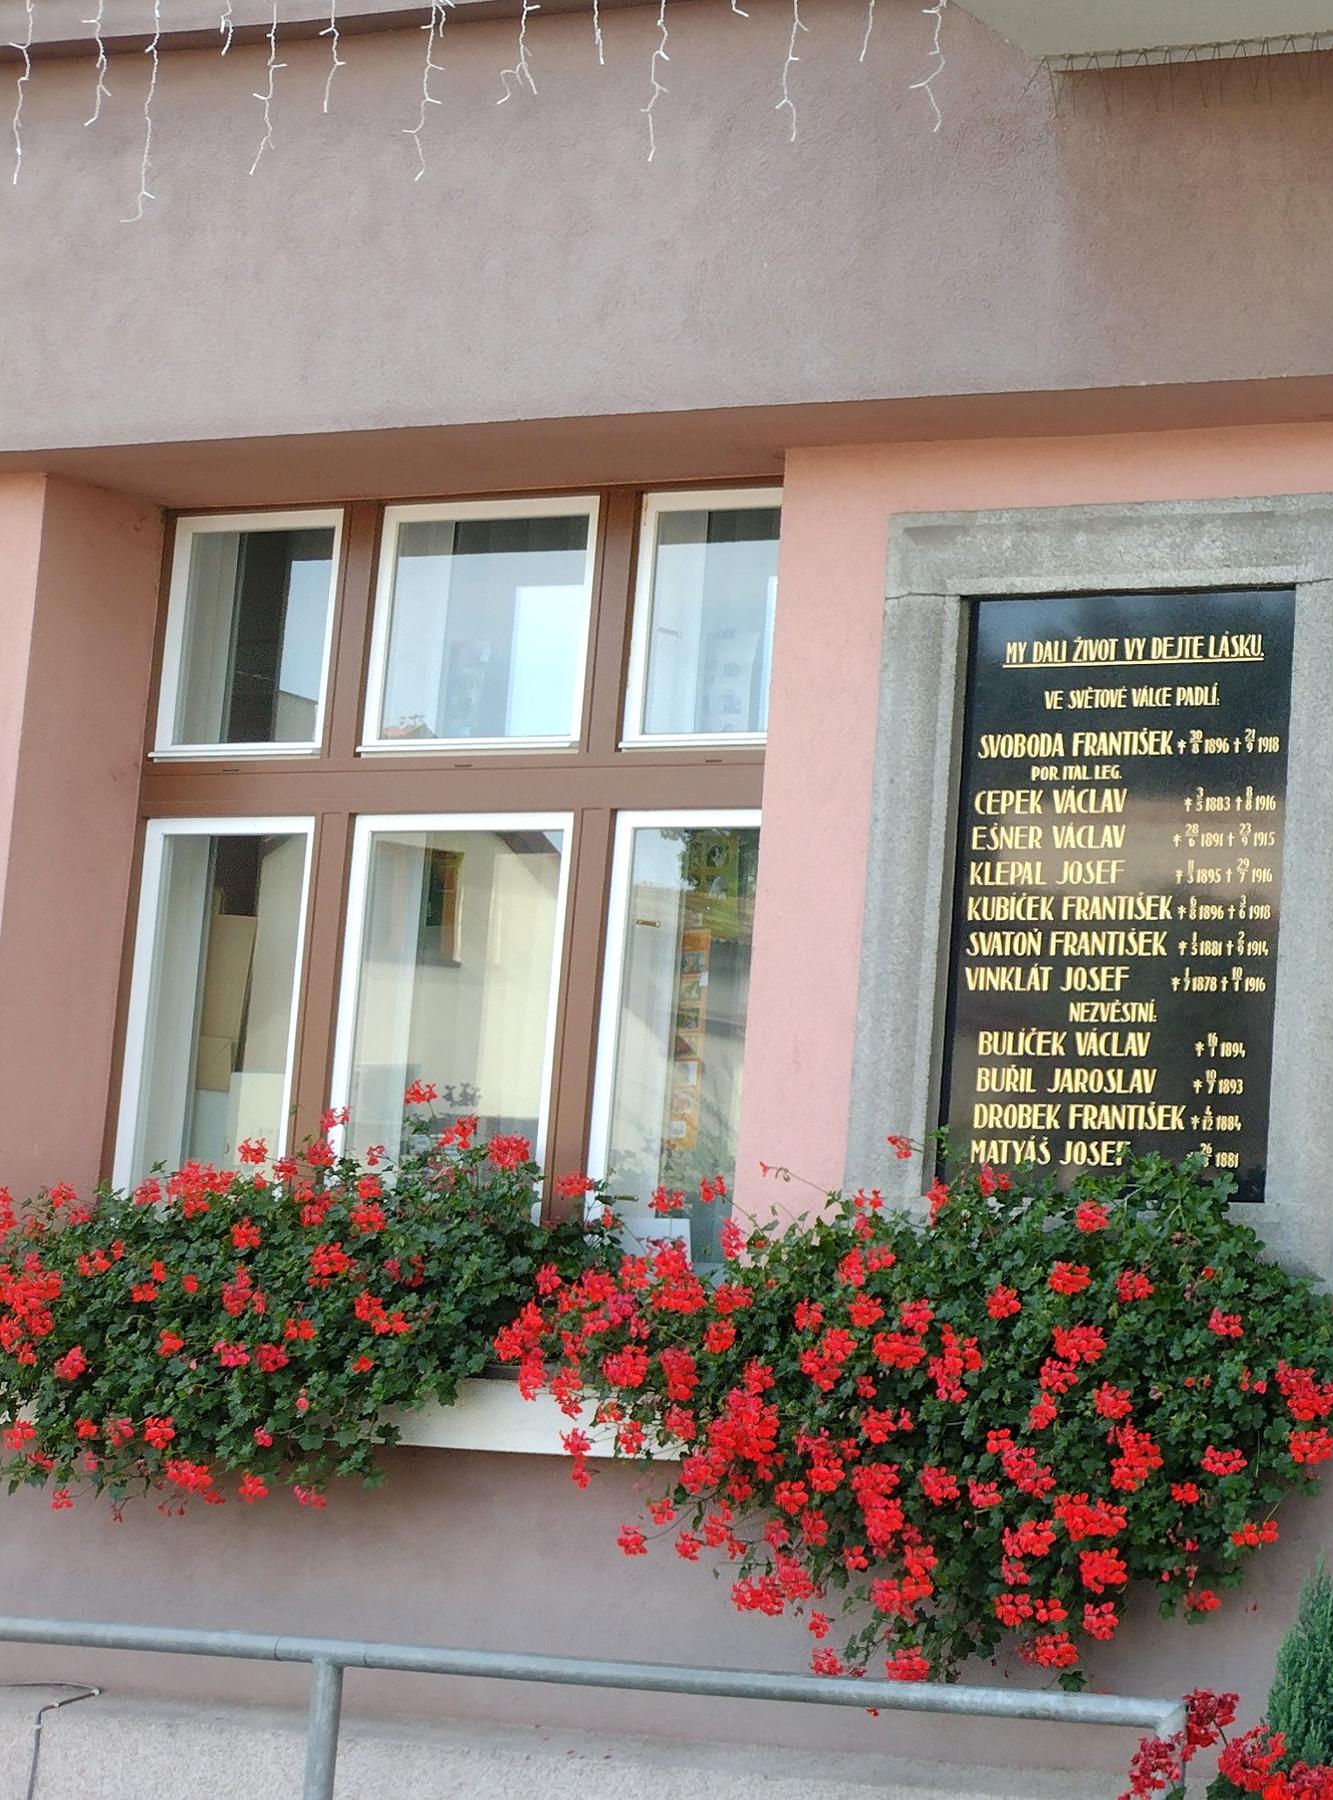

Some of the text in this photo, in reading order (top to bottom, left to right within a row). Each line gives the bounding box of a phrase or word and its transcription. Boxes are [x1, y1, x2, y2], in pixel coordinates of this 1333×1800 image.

[1005, 631, 1265, 664] MY DALI ŽIVOT VY DEJTE LÁSKU.
[1045, 690, 1064, 710] VE
[1068, 686, 1127, 709] SVĚTOVÉ
[1131, 685, 1172, 707] VÁLCE
[978, 731, 1064, 759] SVOBODA
[1072, 727, 1173, 756] FRANTIŠEK
[1204, 738, 1230, 753] 1896
[1258, 737, 1279, 753] 1918
[974, 786, 1276, 815] CEPEK VÁCLAV 1883 1916
[1052, 822, 1126, 849] VÁCLAV
[1201, 832, 1223, 847] 1891
[1254, 832, 1275, 846] 1915
[970, 861, 1047, 885] KLEPAL
[1056, 860, 1126, 885] JOSEF
[1196, 869, 1221, 883] 1895
[1252, 868, 1273, 883] 1916
[967, 892, 1271, 921] KUBÍČEK FRANTIŠEK 1896 1918
[966, 928, 1269, 957] SVATOŇ FRANTIŠEK 1881 1914
[965, 963, 1053, 991] VINKLÁT
[1060, 966, 1130, 992] JOSEF
[1192, 976, 1217, 992] 1878
[1245, 977, 1266, 992] 1916
[978, 1027, 1068, 1057] BULÍČEK
[1075, 1028, 1150, 1057] VÁCLAV
[1220, 1042, 1246, 1058] 1894
[976, 1064, 1036, 1093] BUŘIL
[1047, 1067, 1158, 1094] JAROSLAV
[1218, 1079, 1244, 1094] 1893
[973, 1103, 1061, 1130] DROBEK
[1068, 1101, 1186, 1131] FRANTIŠEK
[1216, 1115, 1242, 1131] 1884
[970, 1135, 1051, 1165] MATYÁŠ
[1215, 1152, 1239, 1168] 1881
